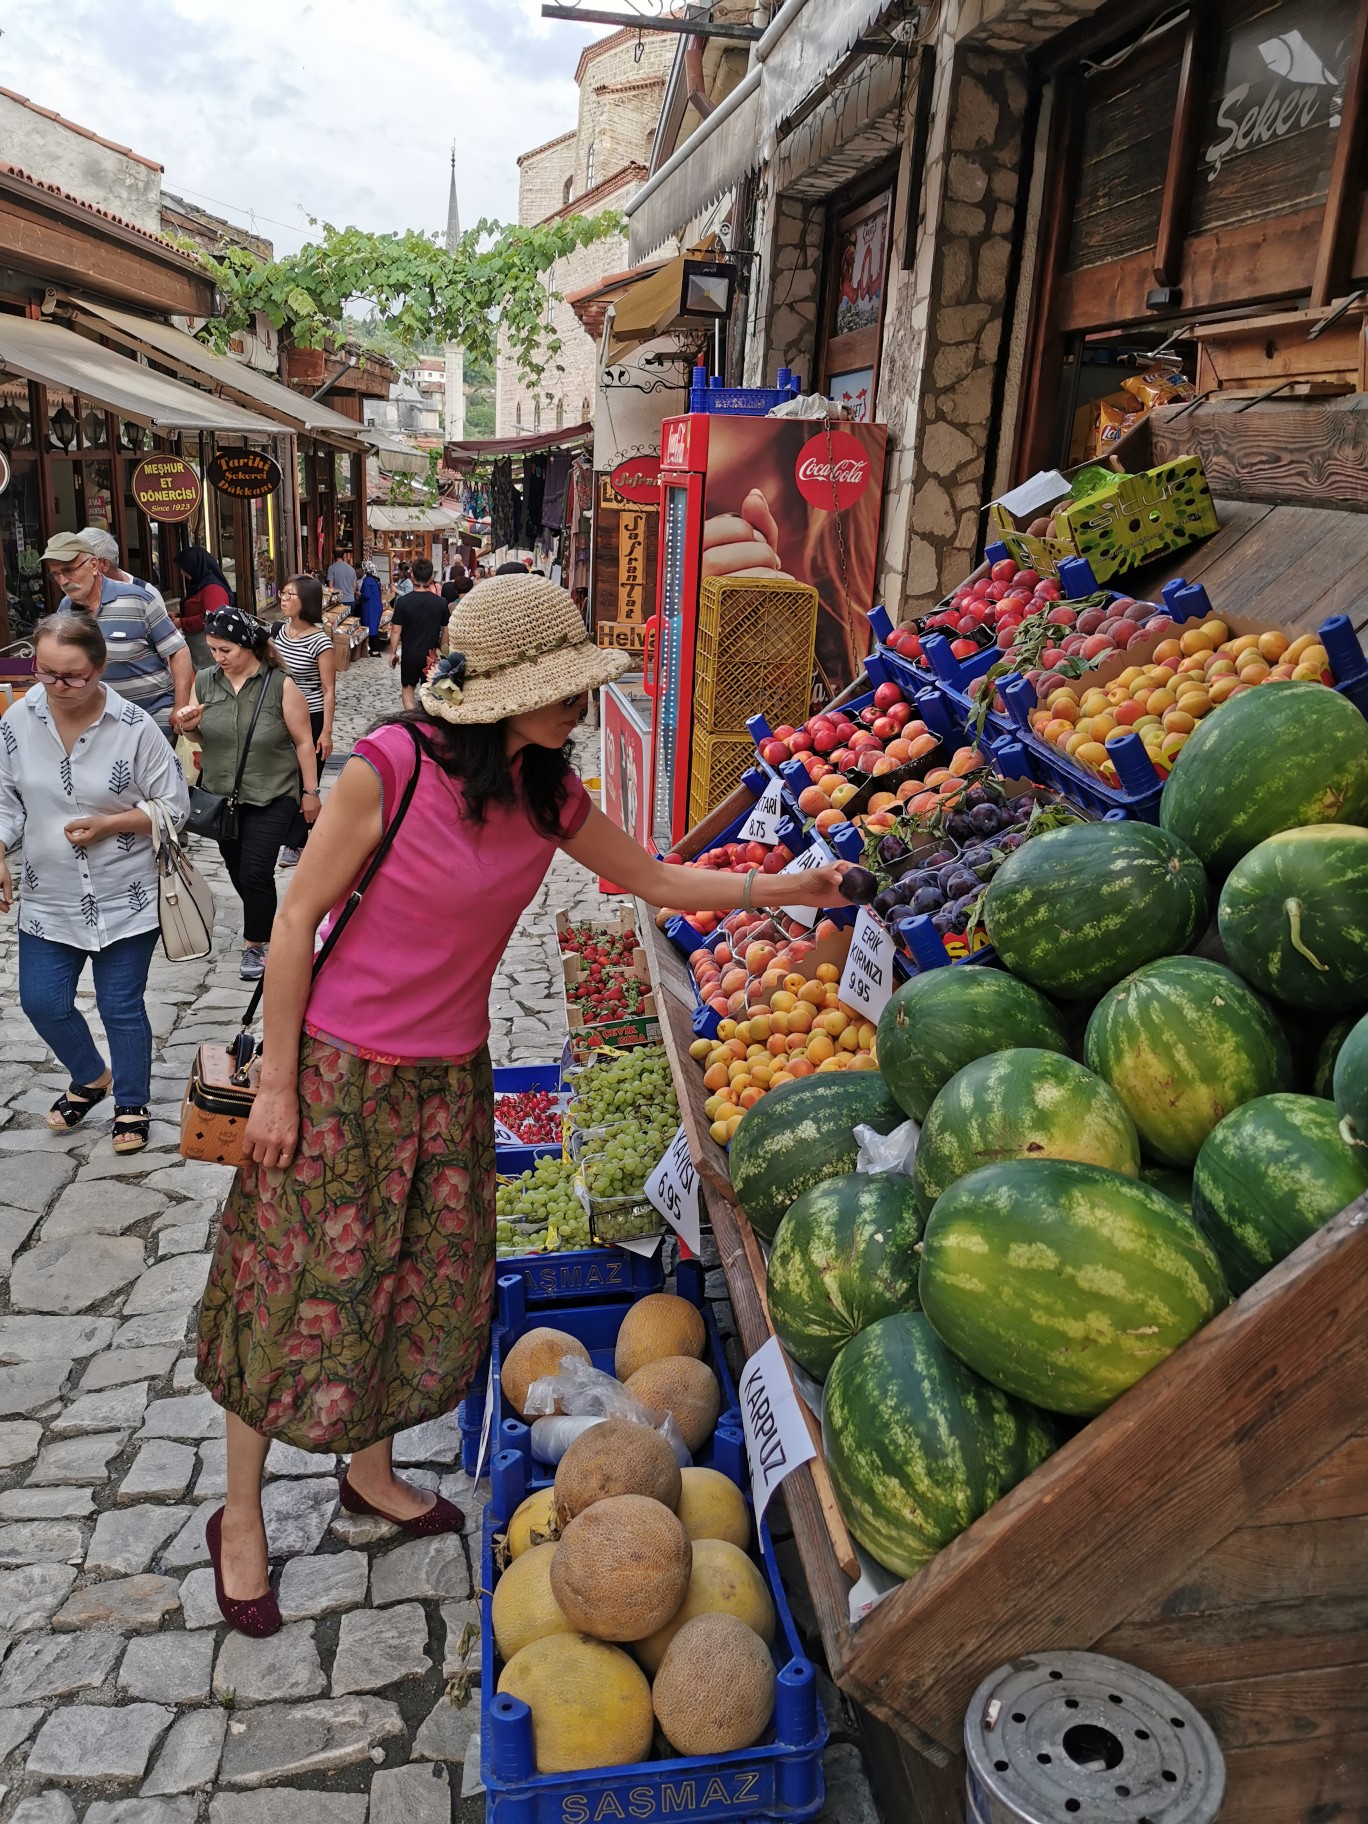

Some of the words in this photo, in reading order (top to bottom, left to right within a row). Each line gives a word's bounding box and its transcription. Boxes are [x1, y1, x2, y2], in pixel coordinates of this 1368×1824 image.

[1205, 79, 1321, 182] Şeker
[144, 462, 185, 476] MEŞHUR
[218, 454, 272, 471] Tarihi
[139, 486, 197, 503] DÖNERCİSİ
[160, 477, 173, 488] ET
[150, 505, 170, 513] Since
[172, 503, 191, 511] 1923
[749, 819, 766, 839] 8.75
[861, 924, 884, 956] ERİK
[849, 942, 883, 988] KIRMIZI
[848, 971, 871, 1003] 9.95
[658, 1171, 682, 1221] 6.95
[744, 1366, 787, 1487] KARPUZ
